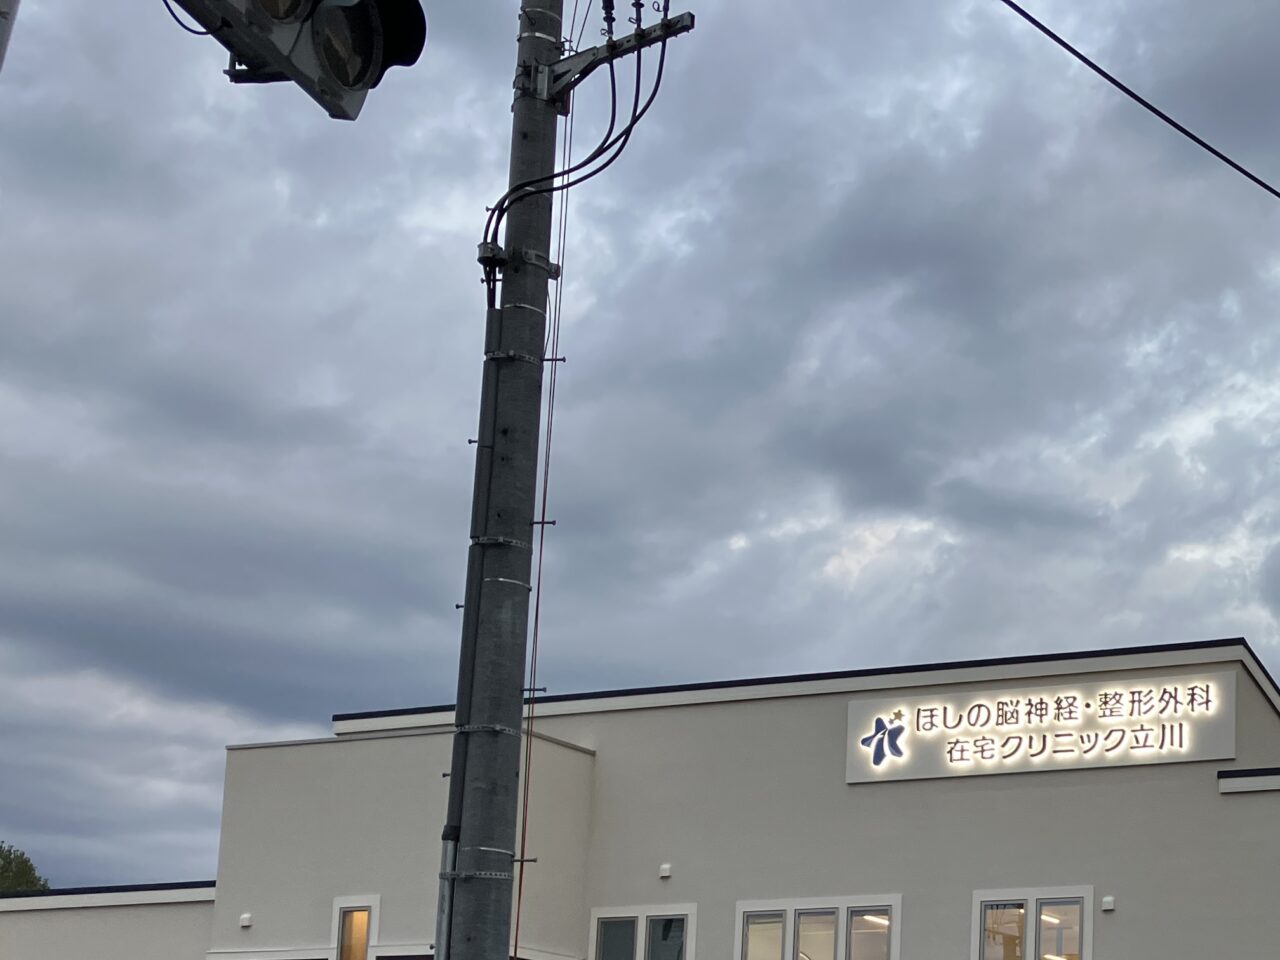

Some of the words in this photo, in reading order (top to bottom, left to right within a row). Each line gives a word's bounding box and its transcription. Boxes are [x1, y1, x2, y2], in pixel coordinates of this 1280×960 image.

[915, 683, 1213, 732] ほしの脳神経・整形外科
[946, 722, 1185, 763] 在宅クリニック立川
